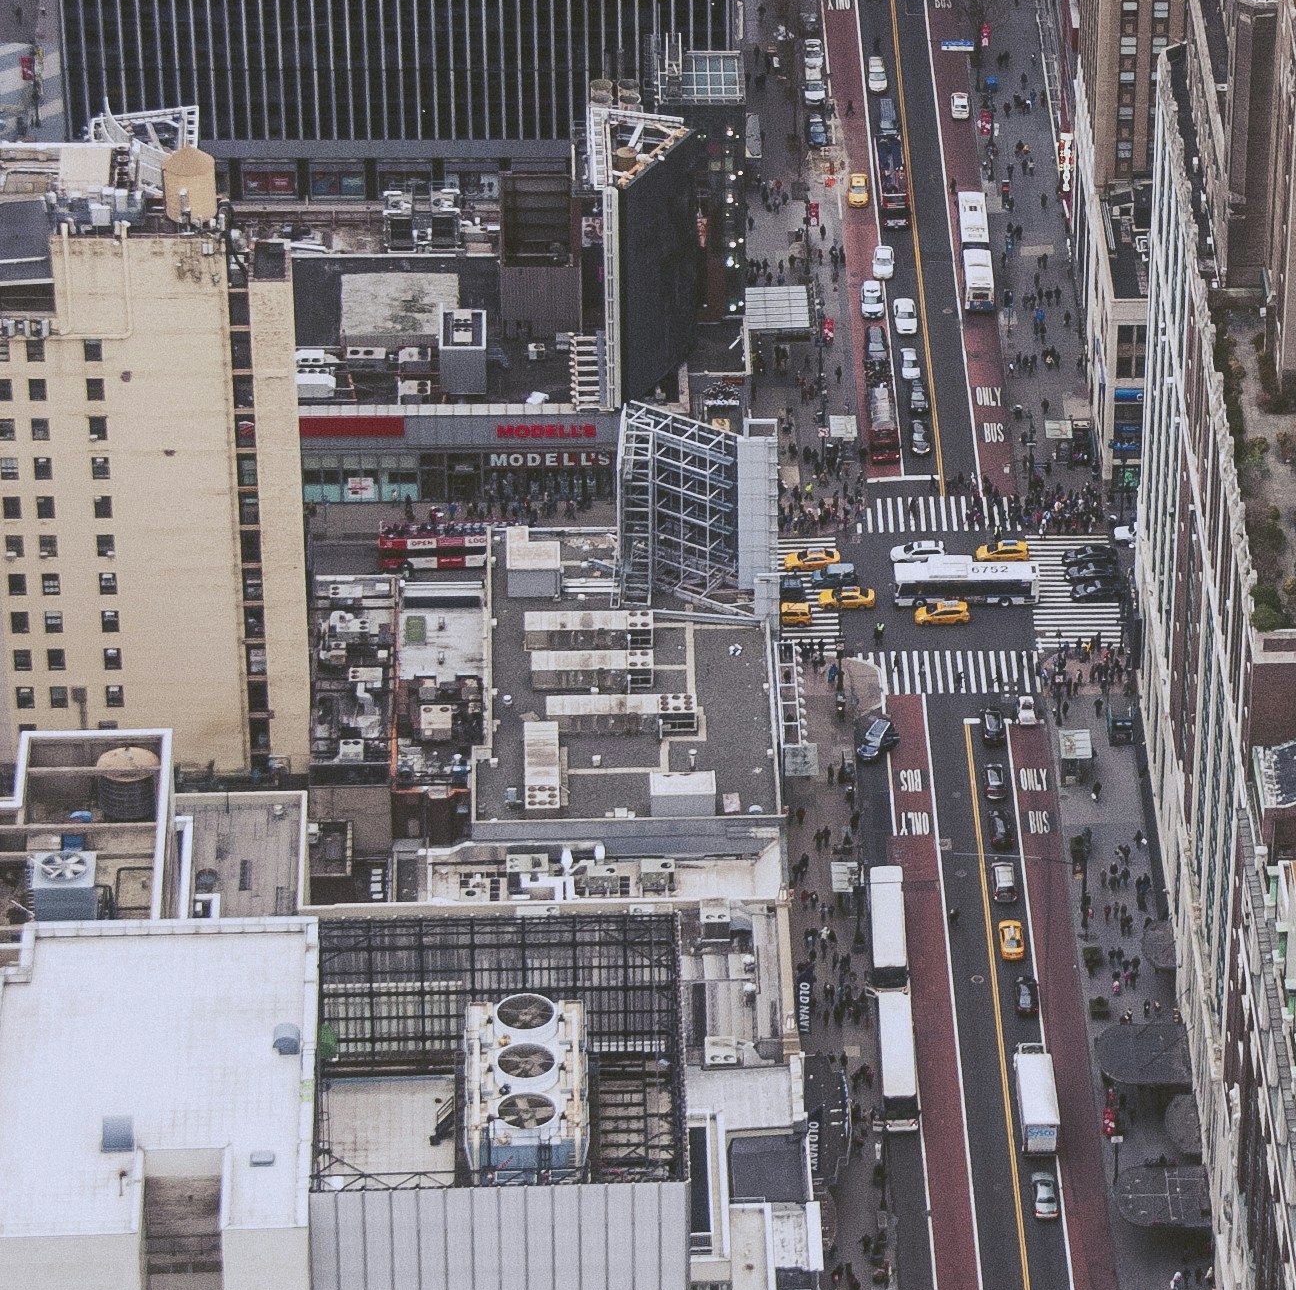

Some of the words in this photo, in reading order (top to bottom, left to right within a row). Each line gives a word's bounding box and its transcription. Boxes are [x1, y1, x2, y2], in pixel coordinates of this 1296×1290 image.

[975, 386, 1002, 408] ONLY
[496, 424, 597, 439] MODELL'S
[983, 422, 1005, 443] BUS
[490, 453, 611, 467] MODELL'S
[971, 564, 1009, 574] 6752
[900, 769, 922, 792] BUS
[1020, 768, 1048, 792] ONLY
[900, 811, 930, 836] ONLY
[1028, 810, 1051, 834] BUS
[800, 981, 810, 1003] OLD
[800, 1005, 810, 1034] NAVY
[808, 1121, 819, 1143] OLD
[810, 1145, 819, 1172] NAVY
